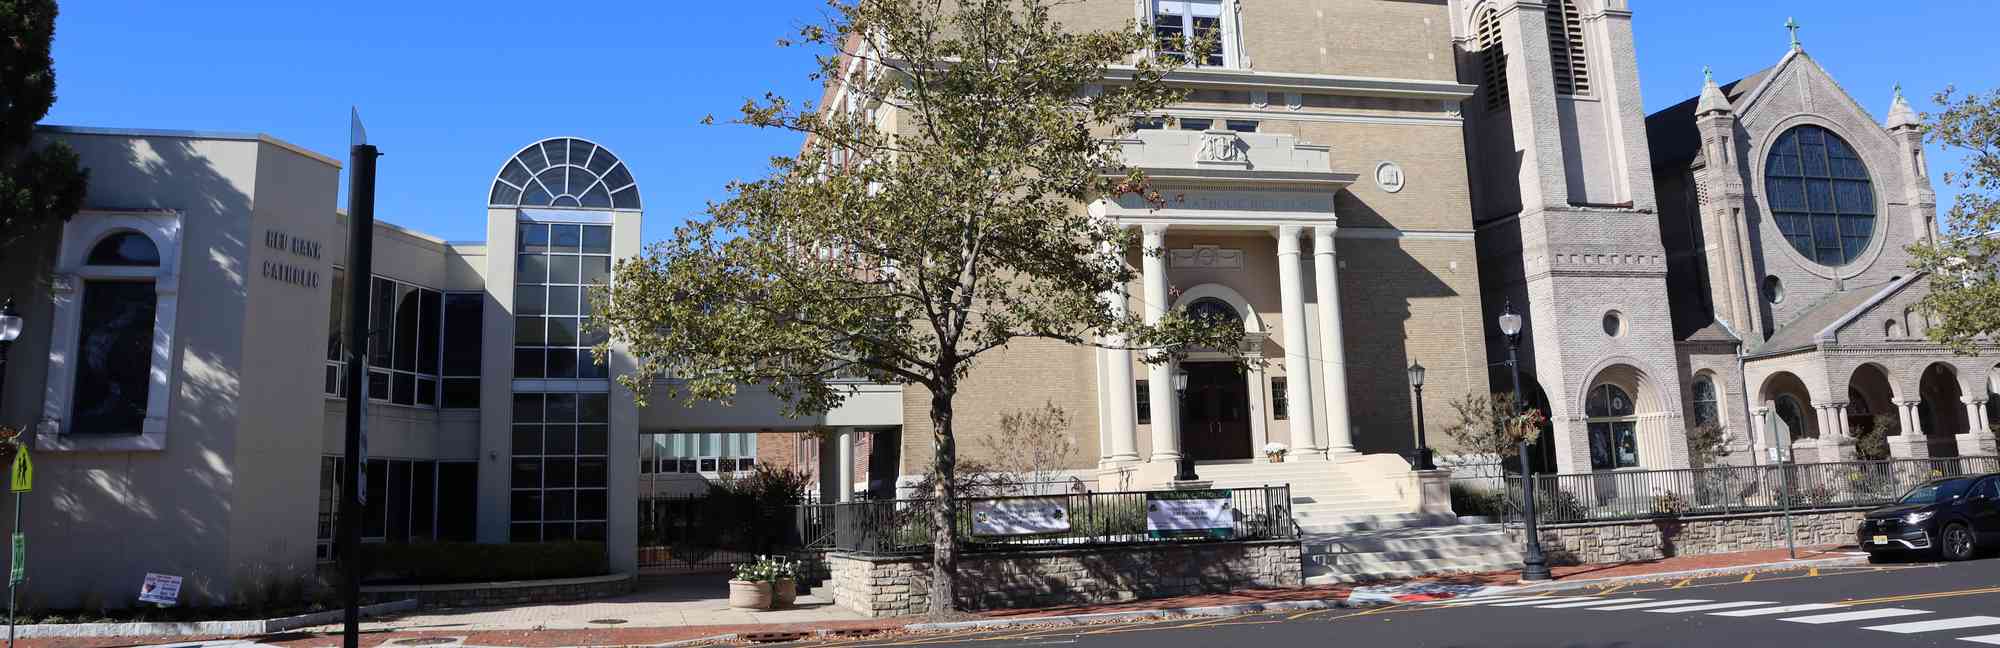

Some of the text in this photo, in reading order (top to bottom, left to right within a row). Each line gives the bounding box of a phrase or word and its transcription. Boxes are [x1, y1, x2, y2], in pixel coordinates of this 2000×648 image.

[265, 230, 321, 259] RED BANK
[263, 260, 321, 289] CATHOLIC
